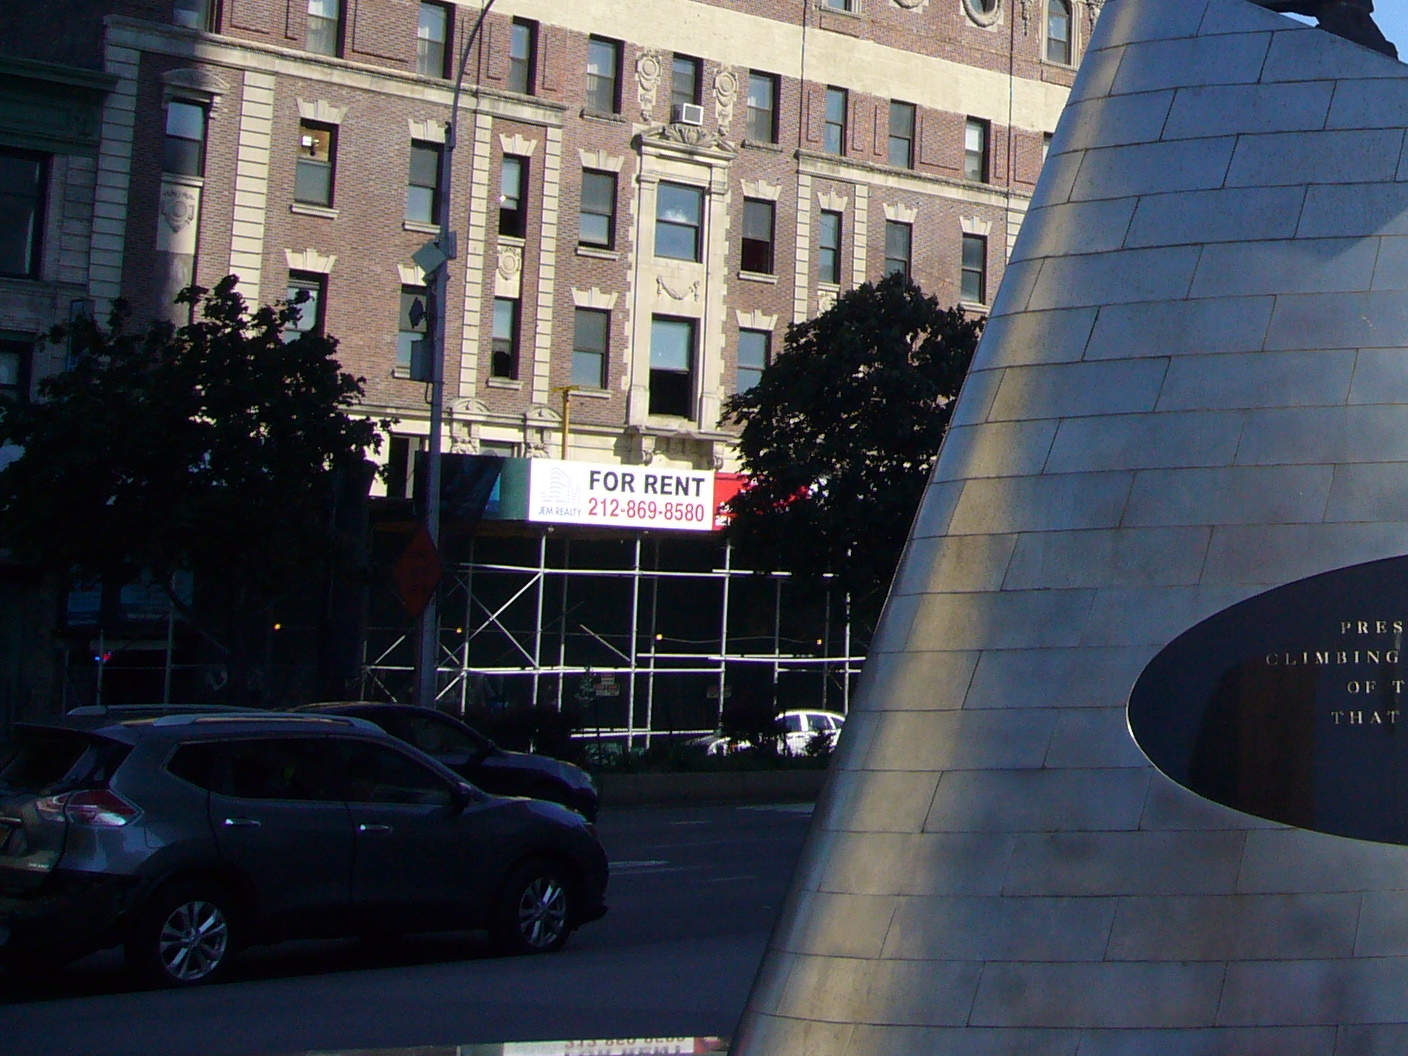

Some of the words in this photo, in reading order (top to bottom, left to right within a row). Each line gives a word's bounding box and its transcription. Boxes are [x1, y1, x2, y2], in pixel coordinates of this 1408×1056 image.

[588, 470, 635, 493] FOR
[643, 473, 705, 497] RENT
[538, 505, 553, 516] JEM
[555, 506, 581, 518] REALTY
[588, 497, 704, 522] 212-869-8580
[1265, 648, 1402, 666] CLIMBING
[1346, 679, 1377, 695] OF
[1330, 709, 1401, 726] THAT
